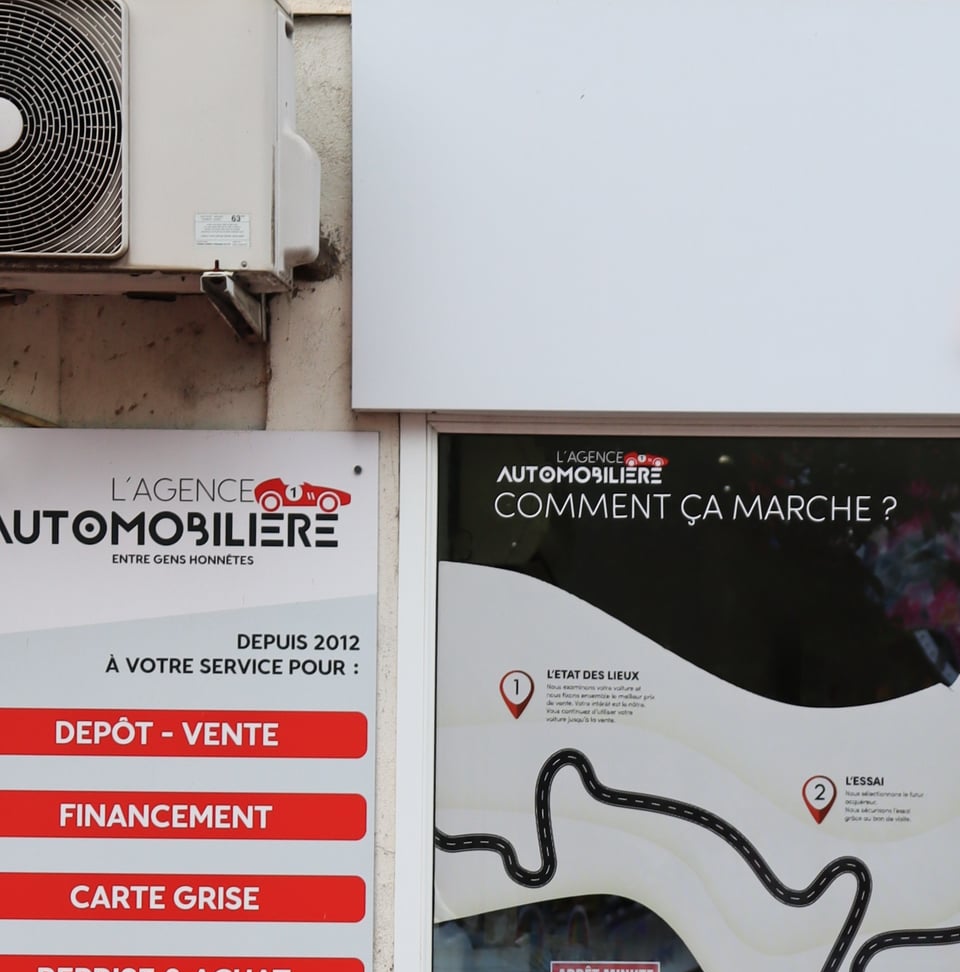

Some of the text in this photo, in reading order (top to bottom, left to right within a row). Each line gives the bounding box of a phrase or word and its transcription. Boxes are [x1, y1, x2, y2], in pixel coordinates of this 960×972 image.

[556, 450, 624, 464] L'AGENCE
[112, 477, 255, 503] L'AGENCE
[494, 492, 898, 527] COMMENT ÇA MARCHE ?
[112, 553, 255, 566] ENTRE GENS HONNÊTES
[237, 634, 360, 651] DEPUIS 2012
[105, 654, 120, 673] À
[125, 657, 194, 674] VOTRE
[199, 658, 284, 675] SERVICE
[288, 659, 346, 676] POUR
[547, 669, 640, 681] L'ETAT DES LIEUX
[513, 678, 520, 696] 1
[54, 716, 154, 745] DEPÔT
[182, 721, 279, 747] VENTE
[845, 776, 885, 786] L'ESSAI
[814, 783, 826, 801] 2
[58, 803, 273, 829] FINANCEMENT
[69, 885, 260, 911] CARTE GRISE
